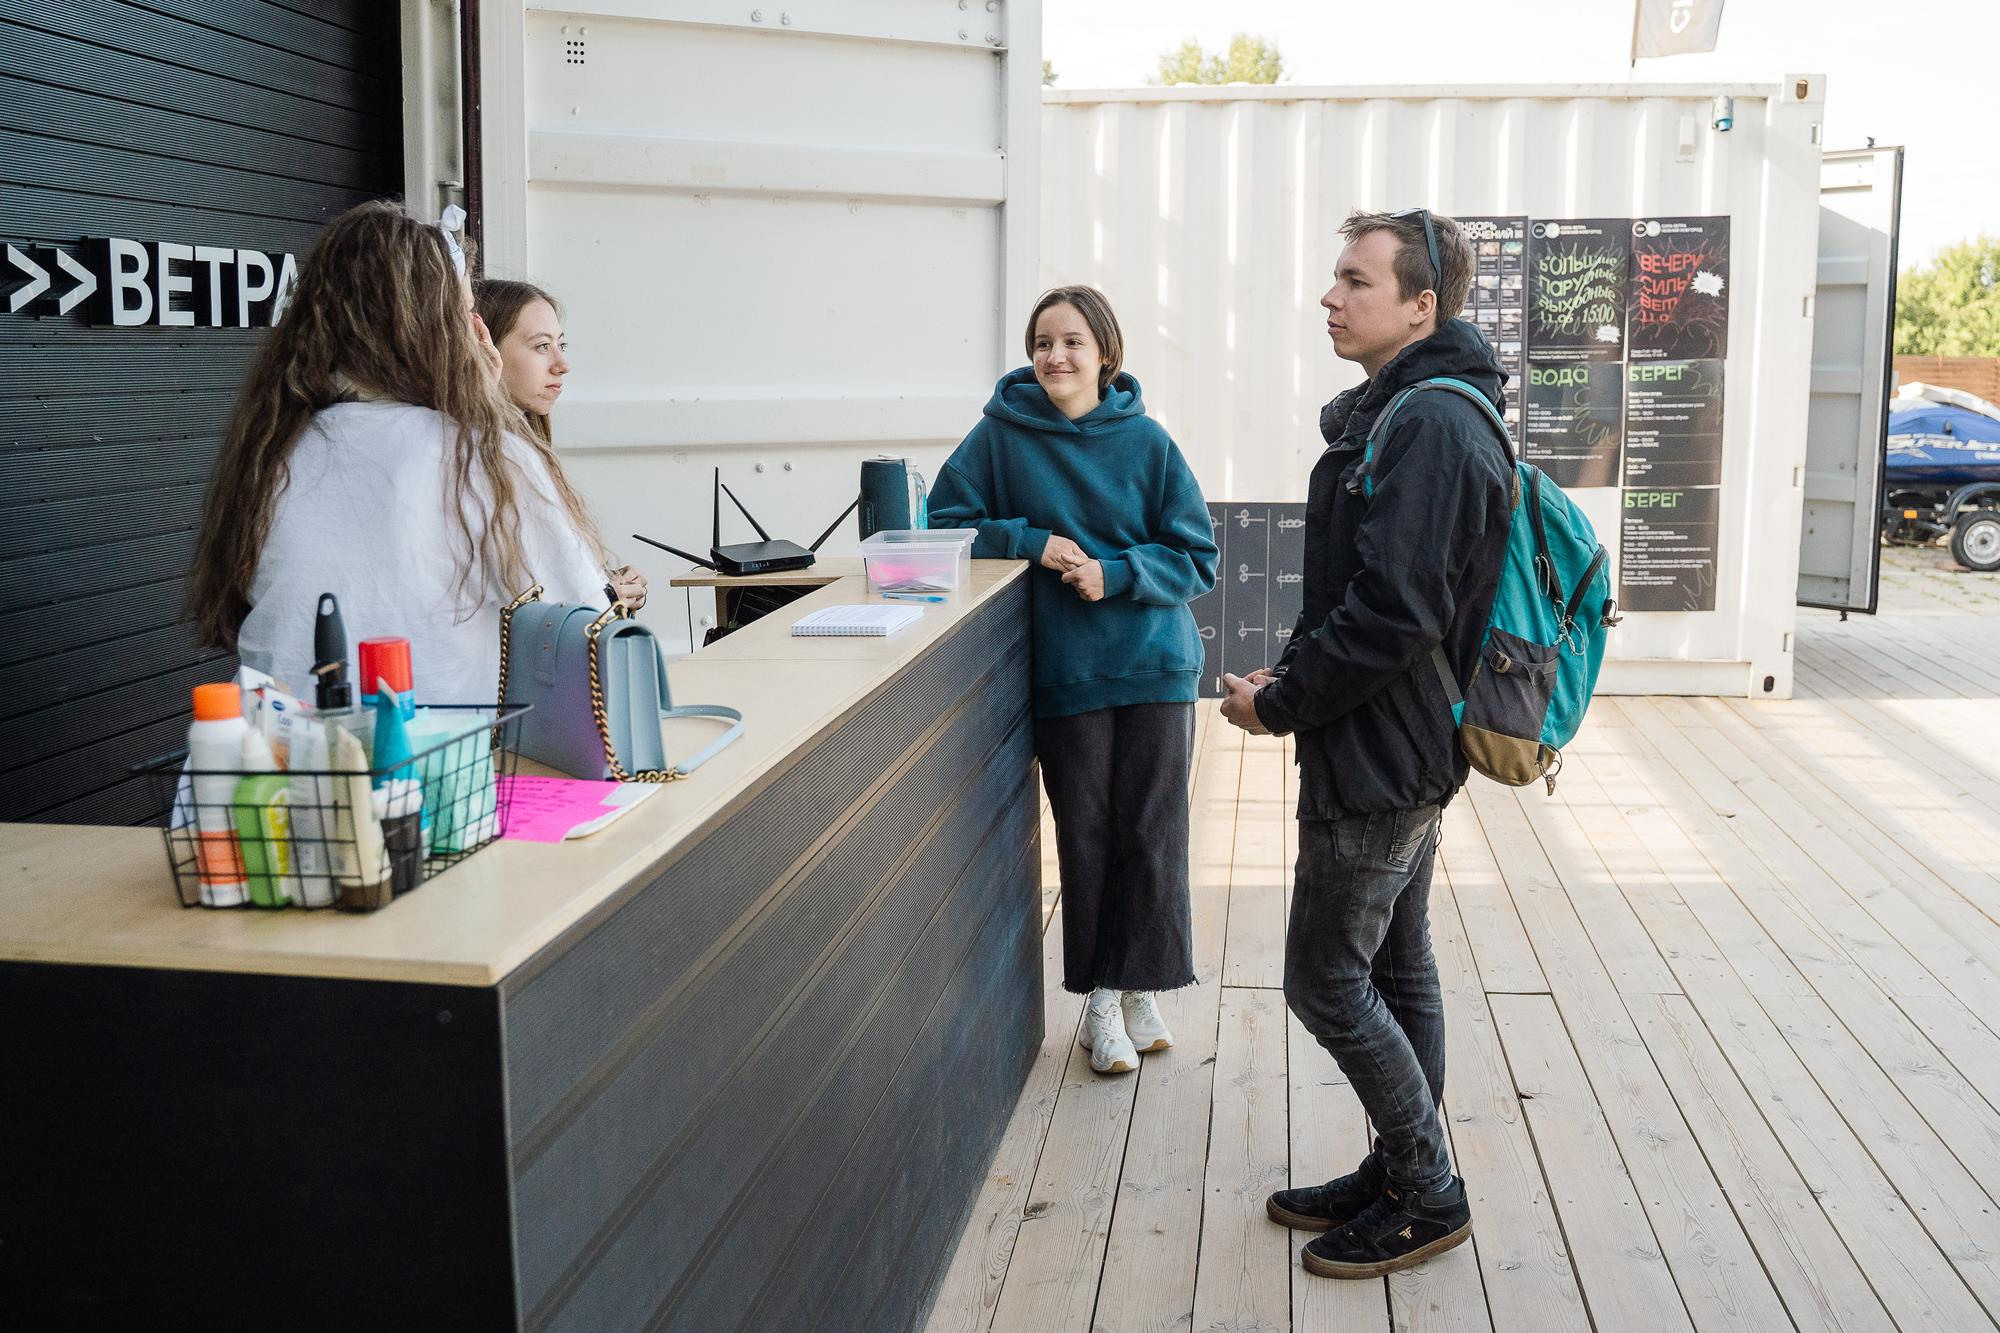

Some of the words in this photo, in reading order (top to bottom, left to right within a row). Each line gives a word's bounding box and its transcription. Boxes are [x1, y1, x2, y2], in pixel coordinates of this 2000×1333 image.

[110, 237, 299, 328] ВЕТРА
[1628, 364, 1689, 382] БЕРЕГ
[1624, 492, 1684, 508] БЕРЕГ
